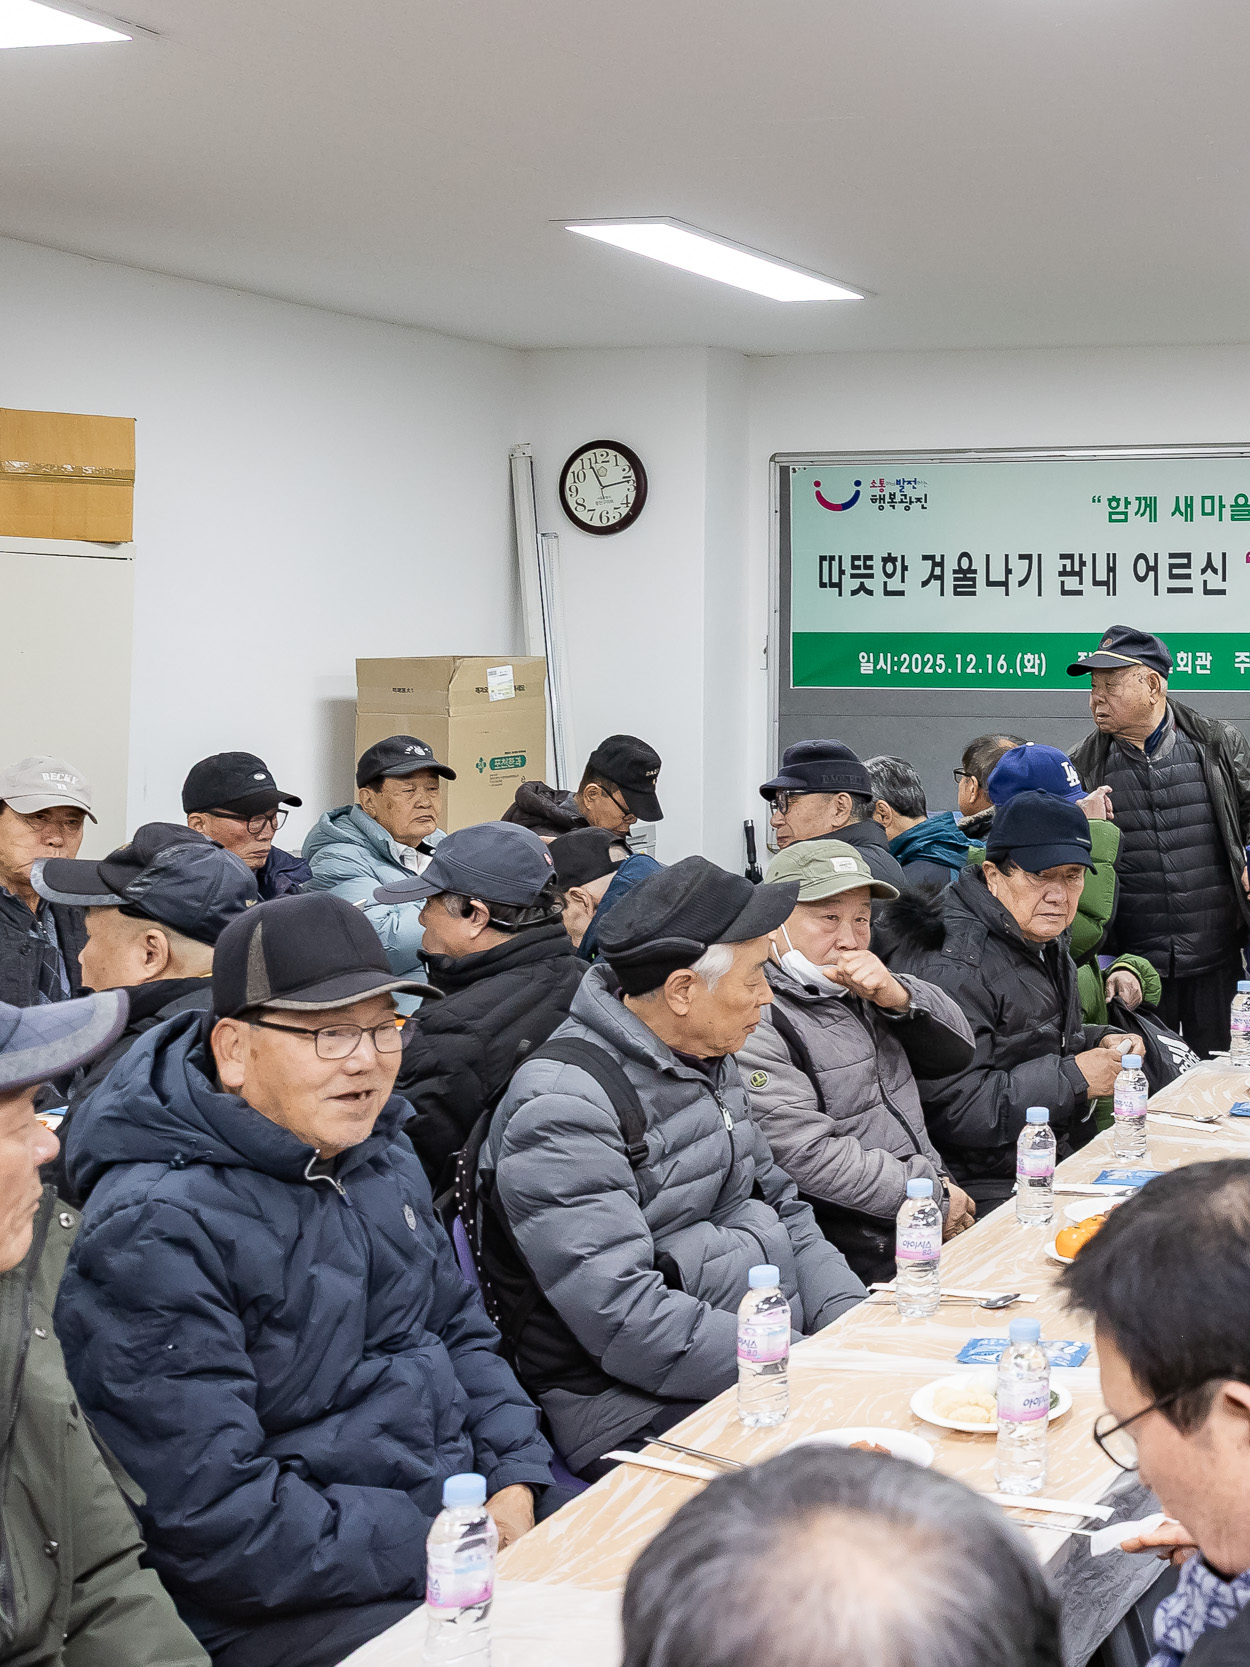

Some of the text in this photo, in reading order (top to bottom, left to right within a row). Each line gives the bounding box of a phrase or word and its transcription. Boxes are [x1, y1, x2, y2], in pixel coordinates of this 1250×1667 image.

[579, 457, 594, 470] 11
[593, 450, 610, 464] 12
[613, 454, 619, 467] 1
[572, 470, 586, 484] 10
[622, 464, 631, 479] 2
[568, 484, 579, 498] 9
[575, 497, 587, 512] 8
[620, 493, 631, 508] 4
[869, 491, 928, 512] 행복광진
[587, 508, 596, 521] 7
[613, 506, 622, 520] 5
[1091, 494, 1158, 523] “함께
[599, 509, 610, 524] 6
[818, 551, 908, 598] 따뜻한
[920, 551, 1043, 597] 겨울나기
[1057, 552, 1117, 597] 관내
[1132, 551, 1228, 597] 어르신
[858, 651, 1047, 677] 일시:2025.12.16.(화)
[1061, 761, 1081, 787] LA
